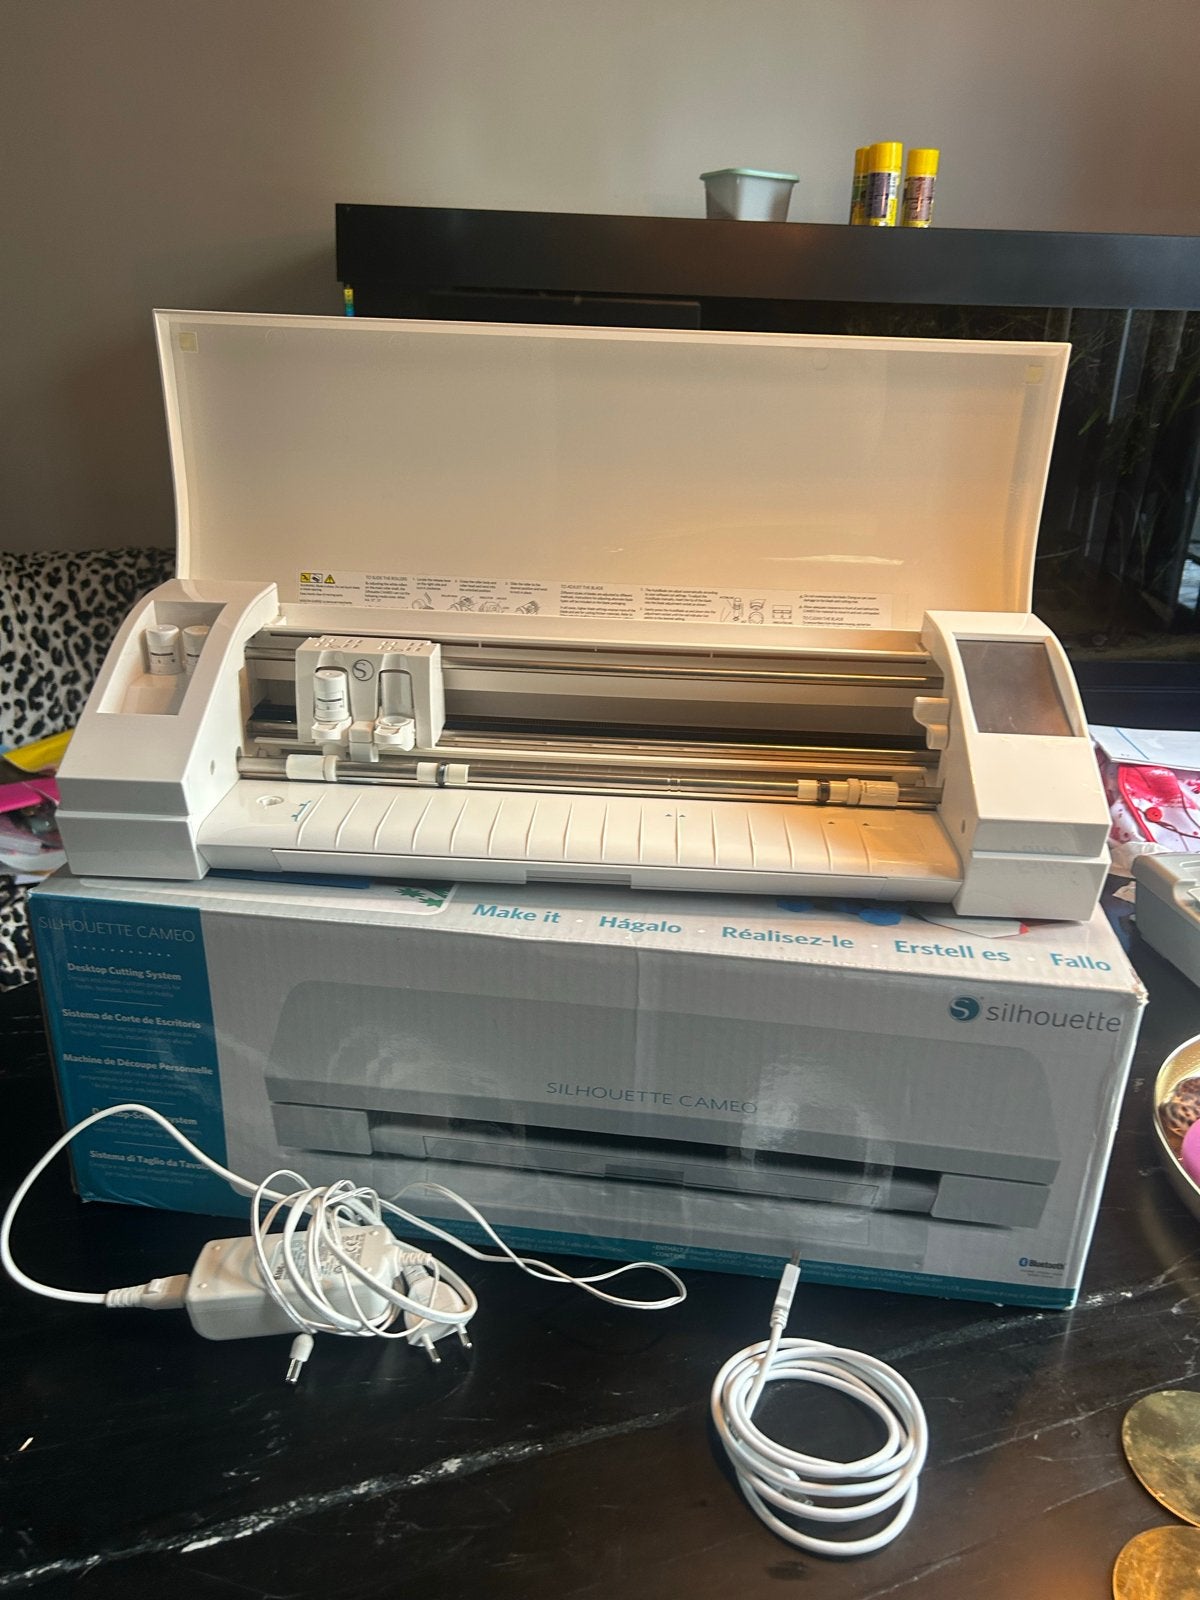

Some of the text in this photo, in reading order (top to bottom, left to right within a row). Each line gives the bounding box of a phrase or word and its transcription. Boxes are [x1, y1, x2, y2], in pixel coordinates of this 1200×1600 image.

[39, 916, 196, 943] SILHOUETTE CAMEO
[472, 903, 1112, 971] Make it Hágalo Réalisez-le Erstell es Fallo
[67, 962, 182, 982] Desktop Cutting System
[62, 1008, 201, 1029] Sistema de Corte de Escritorio
[985, 1002, 1121, 1033] silhouette
[63, 1054, 214, 1076] Machine de Découpe Personnelle
[546, 1081, 758, 1114] SILHOUETTE CAMEO
[90, 1150, 125, 1162] Sistema
[126, 1154, 136, 1162] di
